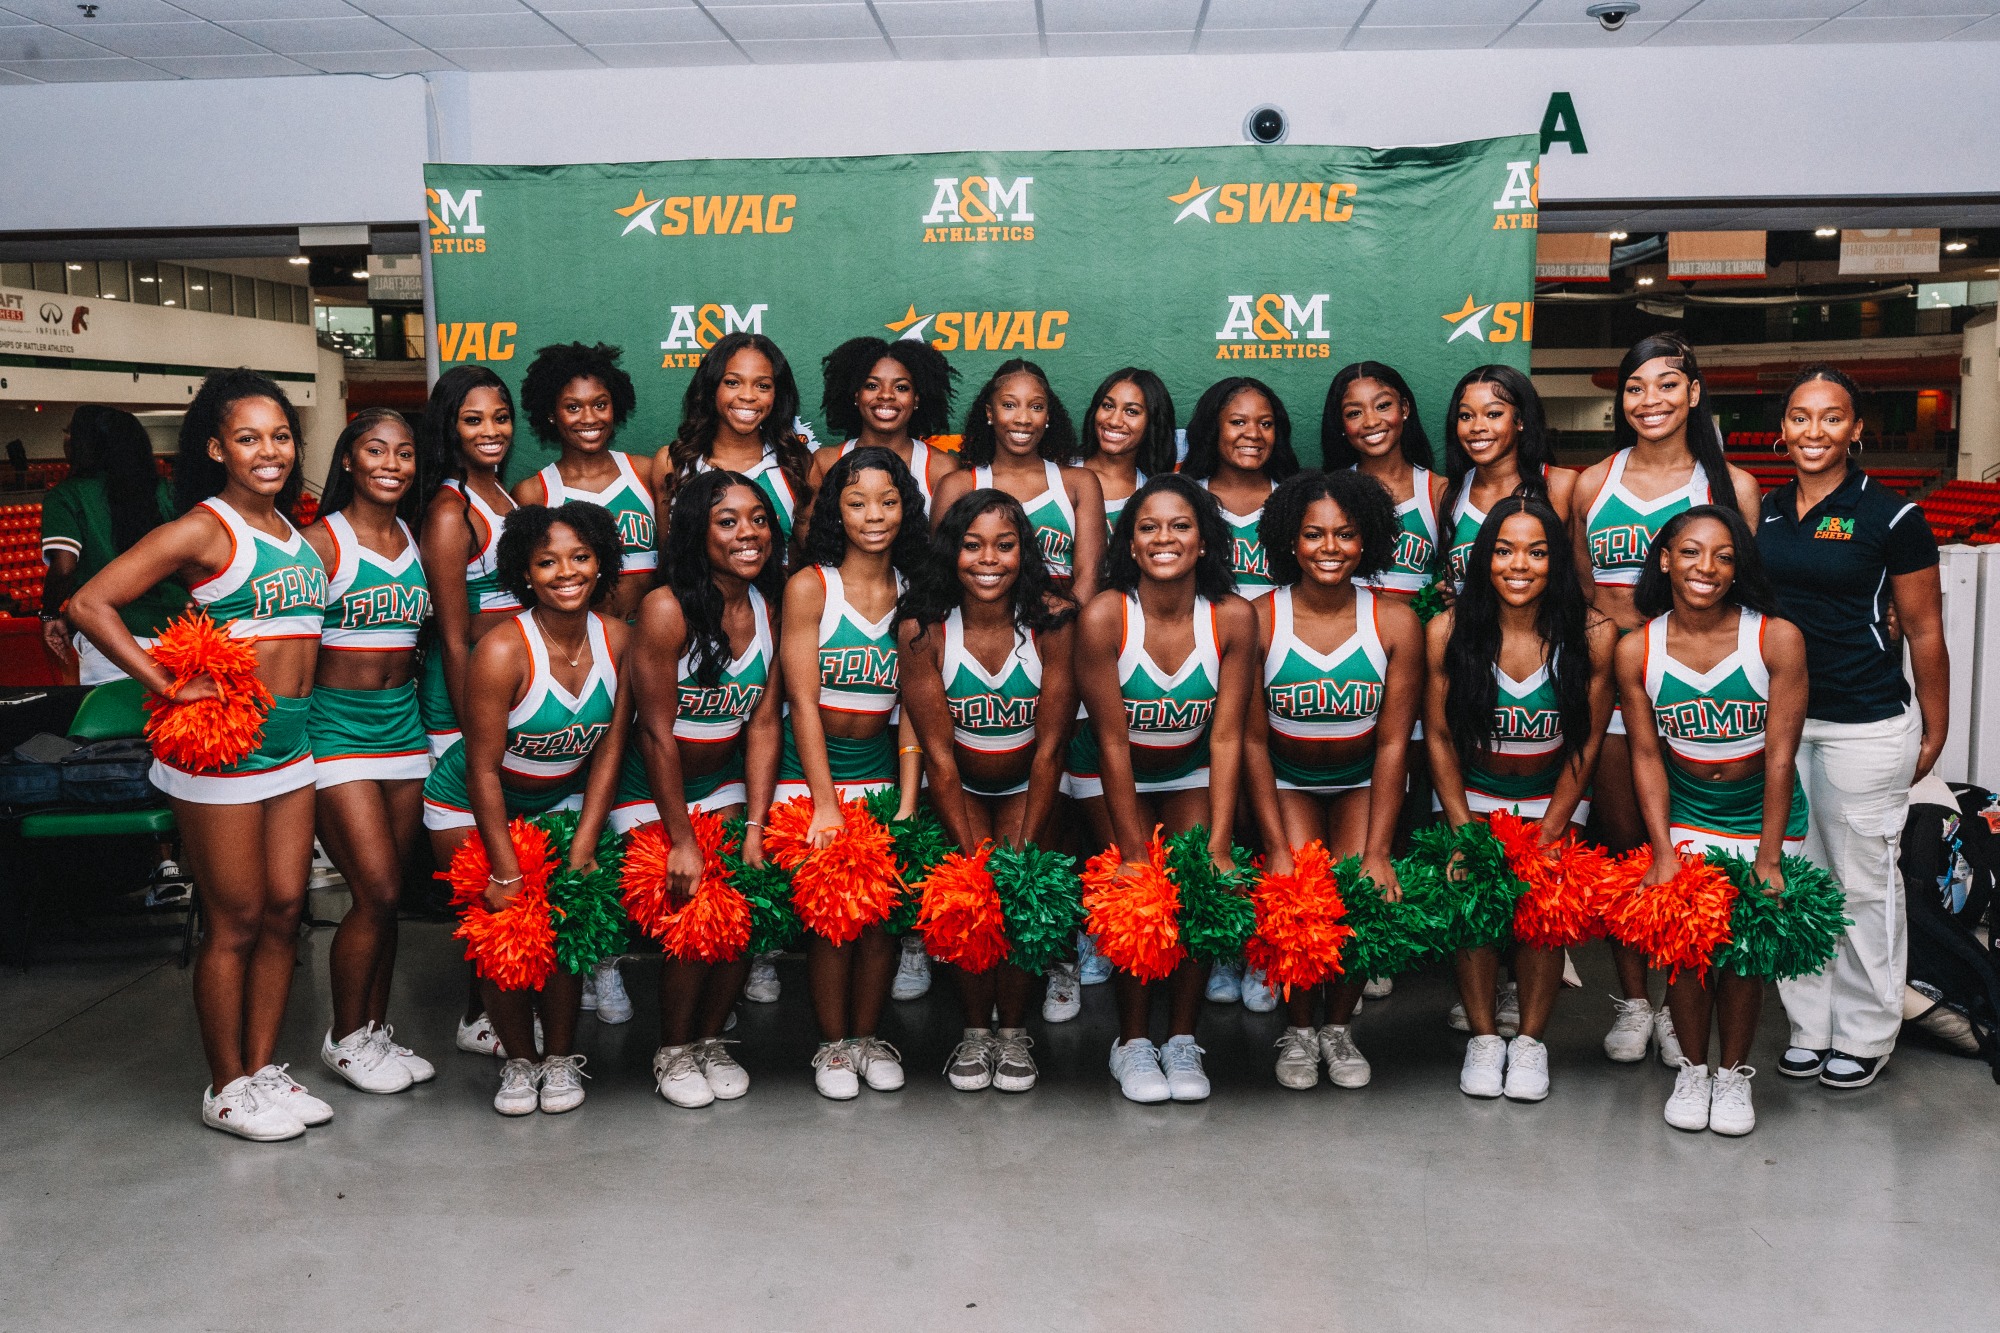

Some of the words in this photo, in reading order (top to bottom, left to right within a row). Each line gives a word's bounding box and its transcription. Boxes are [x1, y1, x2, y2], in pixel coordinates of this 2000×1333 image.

[1539, 92, 1588, 154] A
[661, 194, 796, 236] SWAC
[922, 176, 1034, 223] A&M
[1215, 182, 1358, 224] SWAC
[922, 226, 1035, 243] ATHLETICS
[933, 311, 1069, 350] SWAC
[1216, 293, 1330, 340] A&M
[662, 353, 706, 368] ATH
[1216, 344, 1330, 359] ATHLETICS
[1814, 530, 1852, 540] CHEER
[1816, 516, 1856, 534] A&M
[818, 644, 900, 691] FAM
[1267, 678, 1382, 718] FAMU
[1655, 697, 1767, 738] FAMU
[162, 866, 180, 877] NIKE
